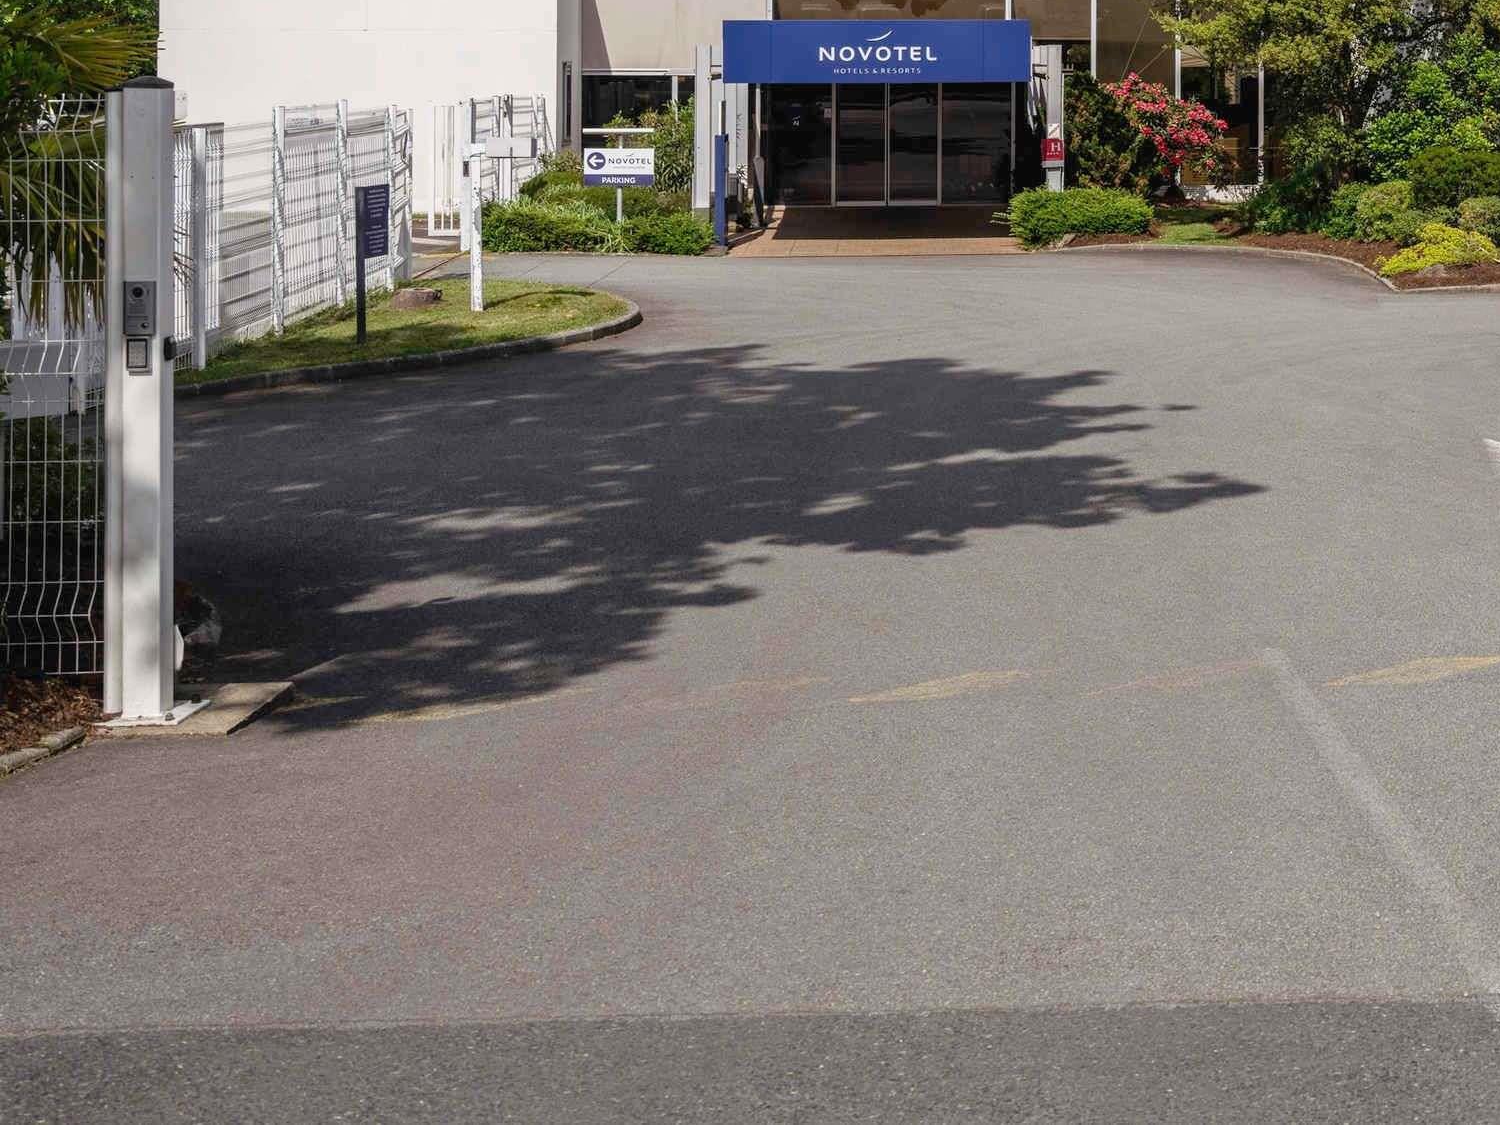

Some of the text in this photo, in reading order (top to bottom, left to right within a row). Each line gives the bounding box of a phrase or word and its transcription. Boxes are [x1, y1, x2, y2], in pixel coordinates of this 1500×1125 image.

[818, 46, 938, 62] NOVOTEL
[833, 67, 922, 75] HOTELS & RESORTS
[1051, 142, 1061, 152] H
[601, 176, 636, 184] PARKING
